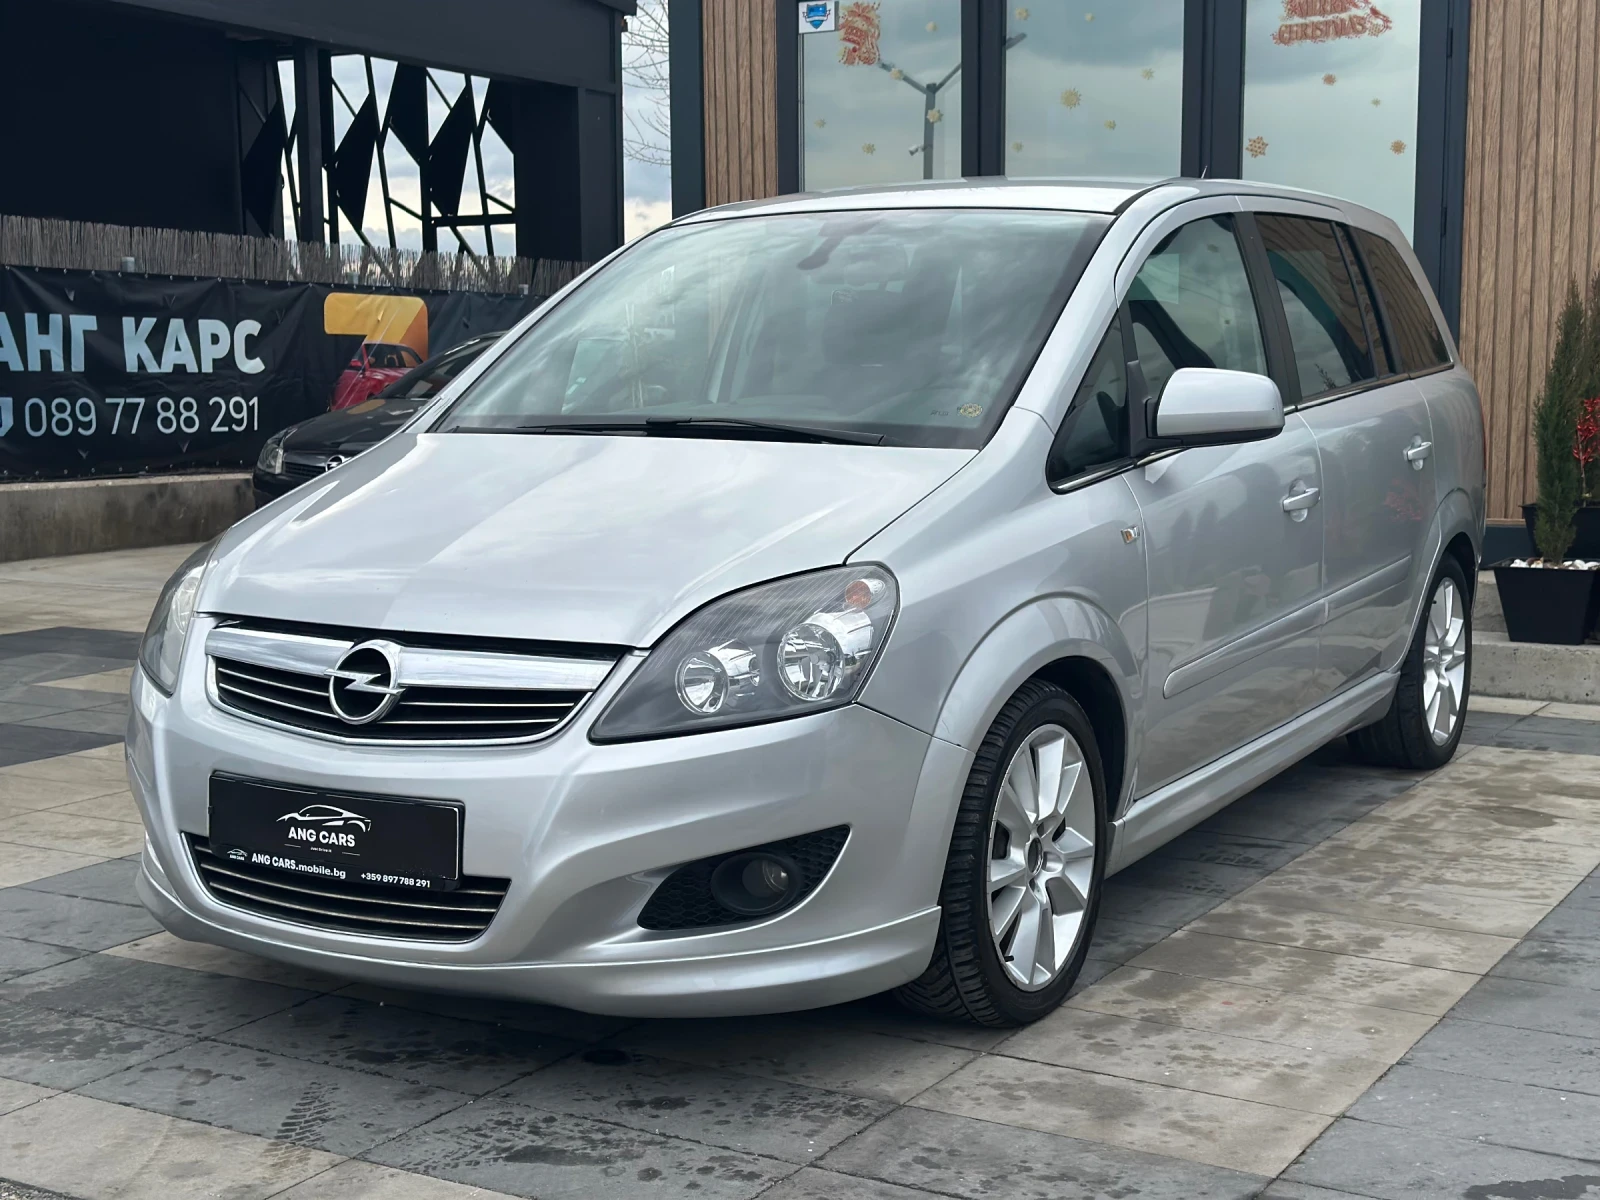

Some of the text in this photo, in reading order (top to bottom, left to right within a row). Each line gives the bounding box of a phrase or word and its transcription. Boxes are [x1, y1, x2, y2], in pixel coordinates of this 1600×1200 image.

[121, 316, 266, 374] КАРС
[24, 396, 259, 437] 089 77 88 291
[287, 826, 356, 847] ANG CARS
[251, 852, 346, 879] ANG CARS.mobile.bg
[360, 872, 431, 888] +359 897 788 291
